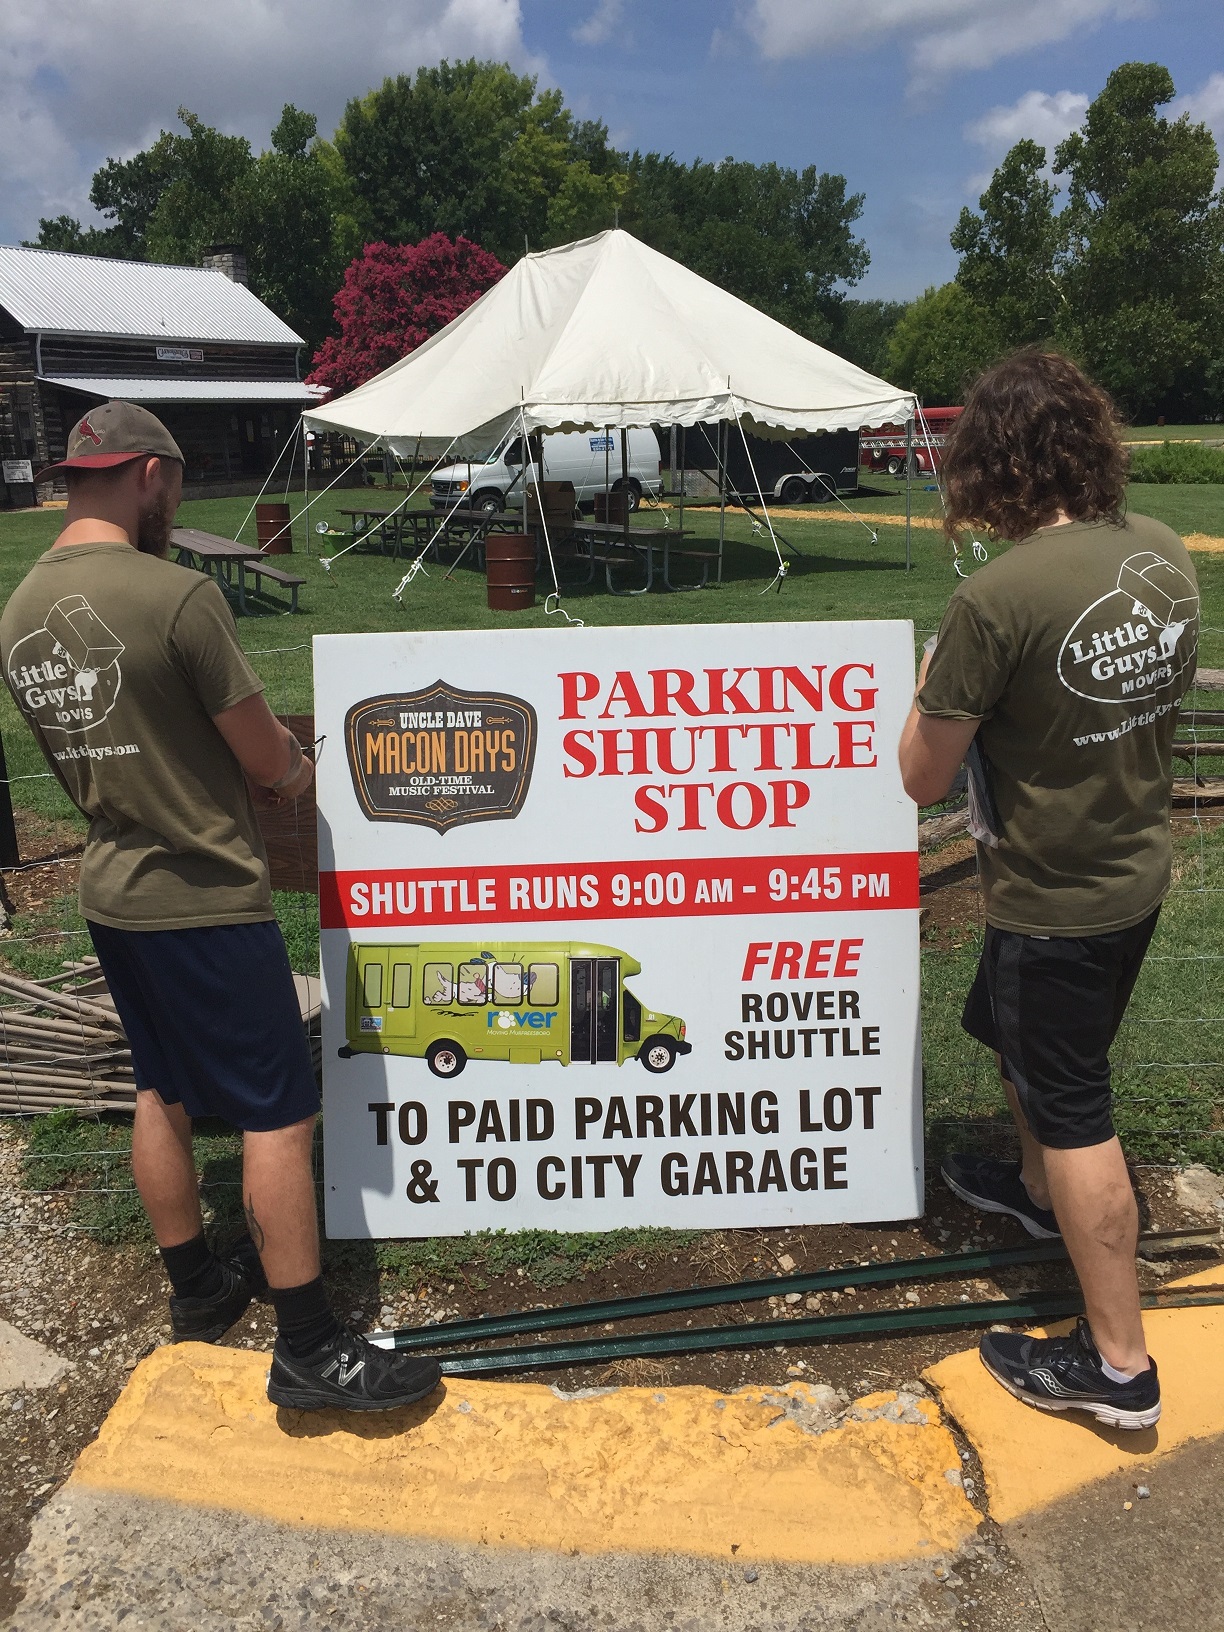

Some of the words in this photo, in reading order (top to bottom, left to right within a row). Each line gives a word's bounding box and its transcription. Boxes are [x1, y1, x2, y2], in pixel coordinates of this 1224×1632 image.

[1069, 622, 1149, 664] Little
[1091, 645, 1156, 681] Guys
[10, 661, 68, 689] Little
[557, 663, 879, 720] PARKING
[25, 686, 79, 709] Guys
[399, 712, 444, 729] UNCLE
[447, 711, 482, 728] DAVE
[366, 731, 446, 774] MACON
[454, 729, 516, 773] DAYS
[562, 720, 878, 778] SHUTTLE
[389, 786, 430, 796] MUSIC
[433, 785, 495, 795] FESTIVAL
[410, 776, 472, 786] OLD-TIME
[634, 780, 811, 833] STOP
[350, 878, 496, 916] SHUTTLE
[509, 874, 599, 910] RUNS
[611, 872, 686, 907] 9:00
[694, 878, 733, 904] AM
[768, 867, 842, 901] 9:45
[851, 873, 890, 898] PM
[741, 938, 864, 981] FREE
[741, 990, 860, 1023] ROVER
[724, 1026, 881, 1061] SHUTTLE
[368, 1101, 428, 1146] TO
[448, 1098, 555, 1143] PAID
[574, 1090, 779, 1140] PARKING
[799, 1086, 882, 1132] LOT
[406, 1159, 440, 1204] &
[457, 1157, 517, 1202] TO
[536, 1154, 643, 1200] CITY
[660, 1146, 848, 1197] GARAGE
